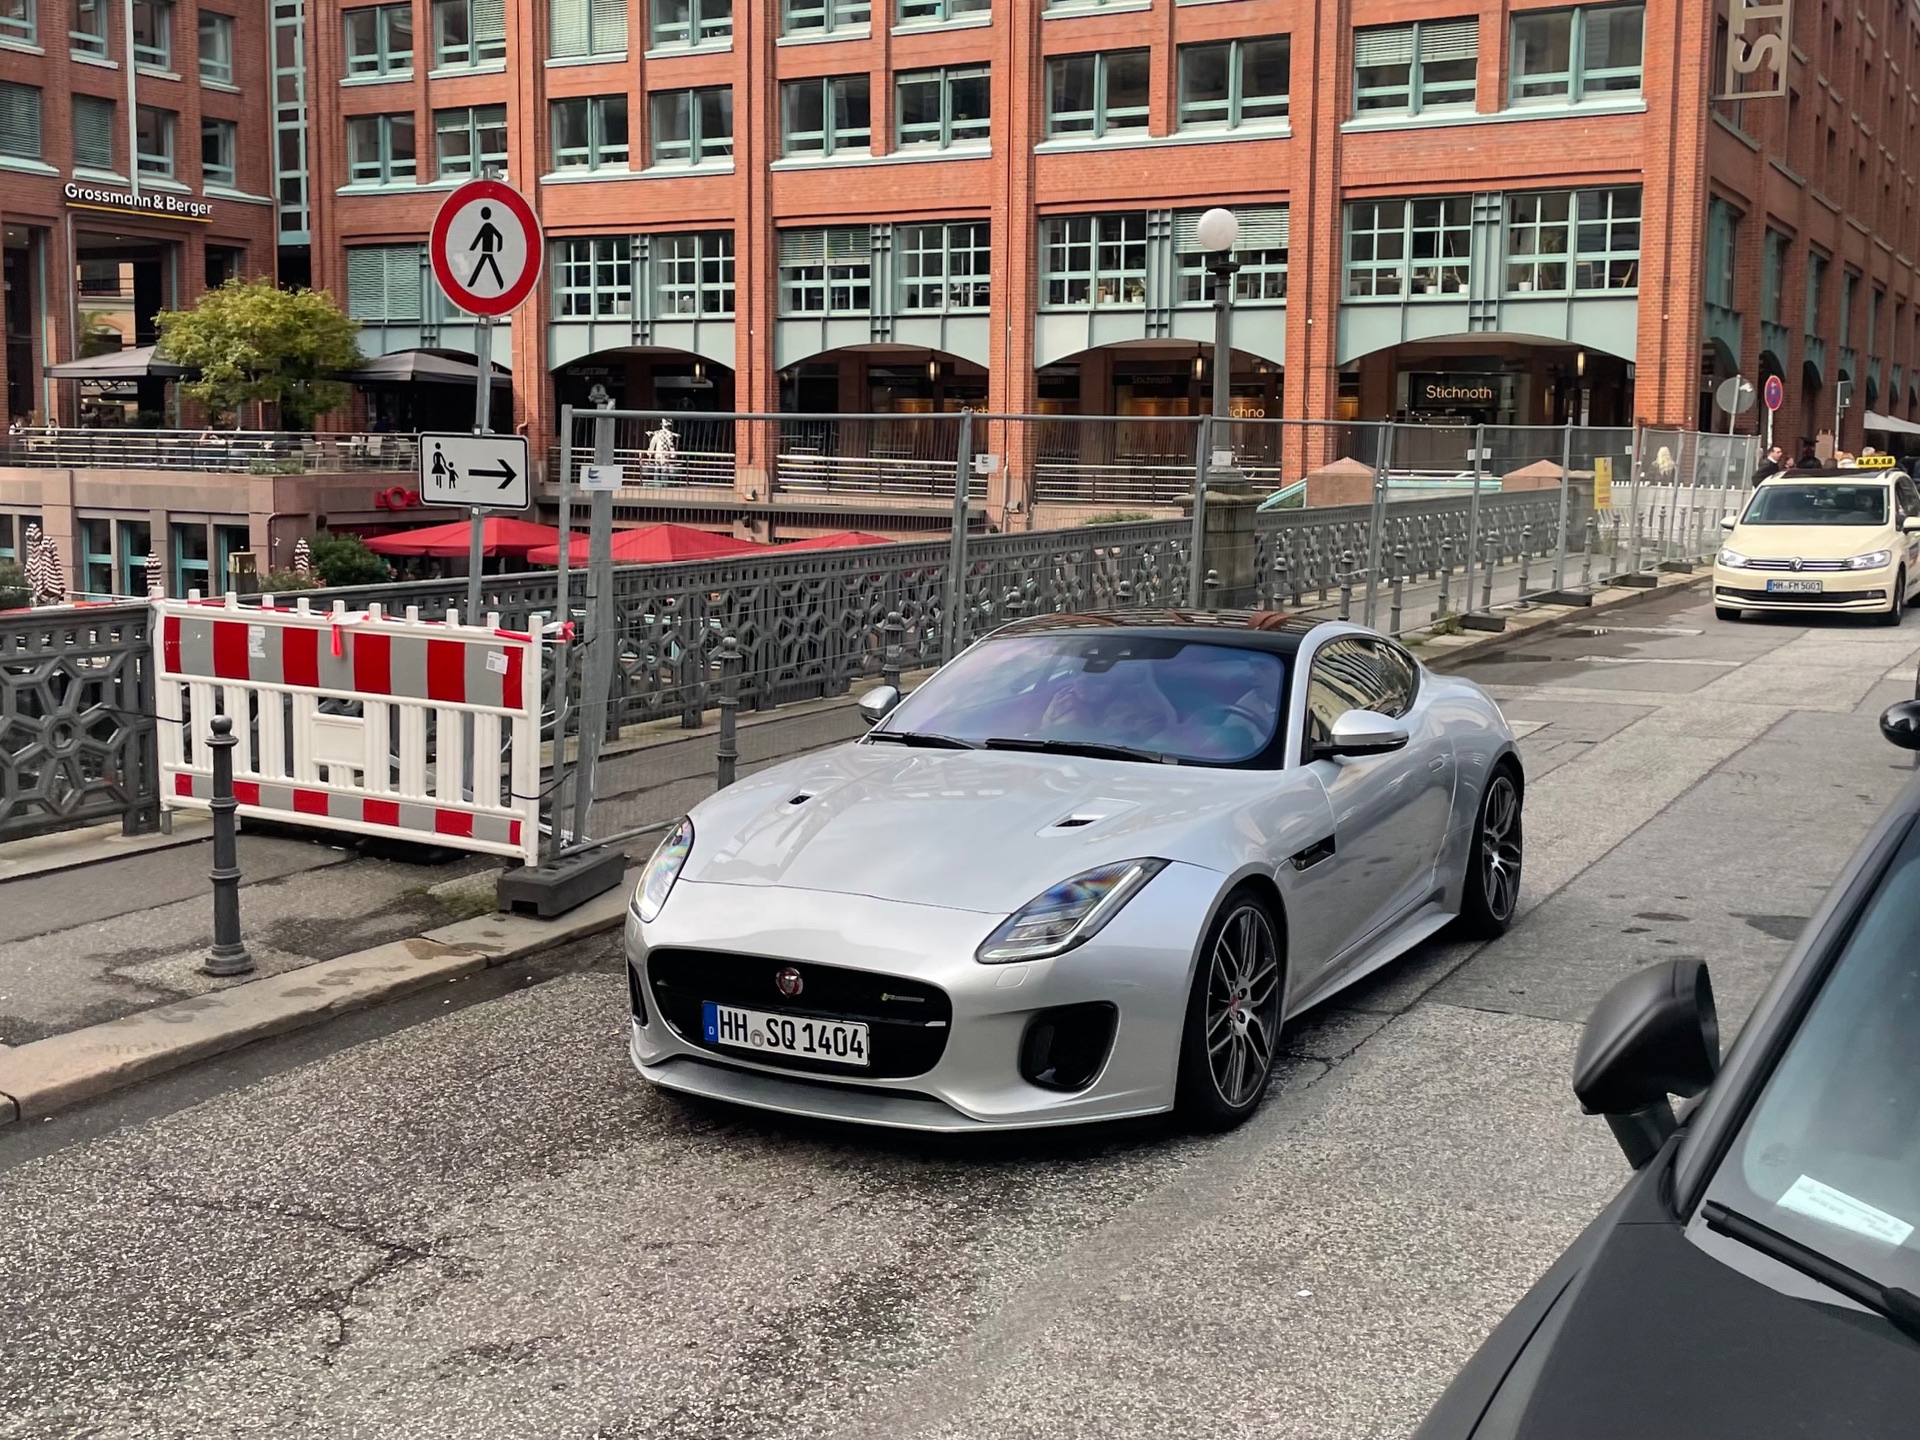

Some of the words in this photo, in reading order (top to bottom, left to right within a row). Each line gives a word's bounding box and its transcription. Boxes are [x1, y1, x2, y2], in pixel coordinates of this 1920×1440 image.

[64, 182, 151, 207] Grossmann
[153, 194, 164, 209] &
[166, 196, 213, 217] Berger
[1426, 385, 1492, 399] Stichnoth
[1228, 406, 1265, 418] ichno
[1859, 457, 1892, 466] TAXI
[708, 1026, 715, 1036] D
[719, 1009, 749, 1043] HH
[766, 1018, 796, 1050] SQ
[802, 1023, 864, 1059] 1404
